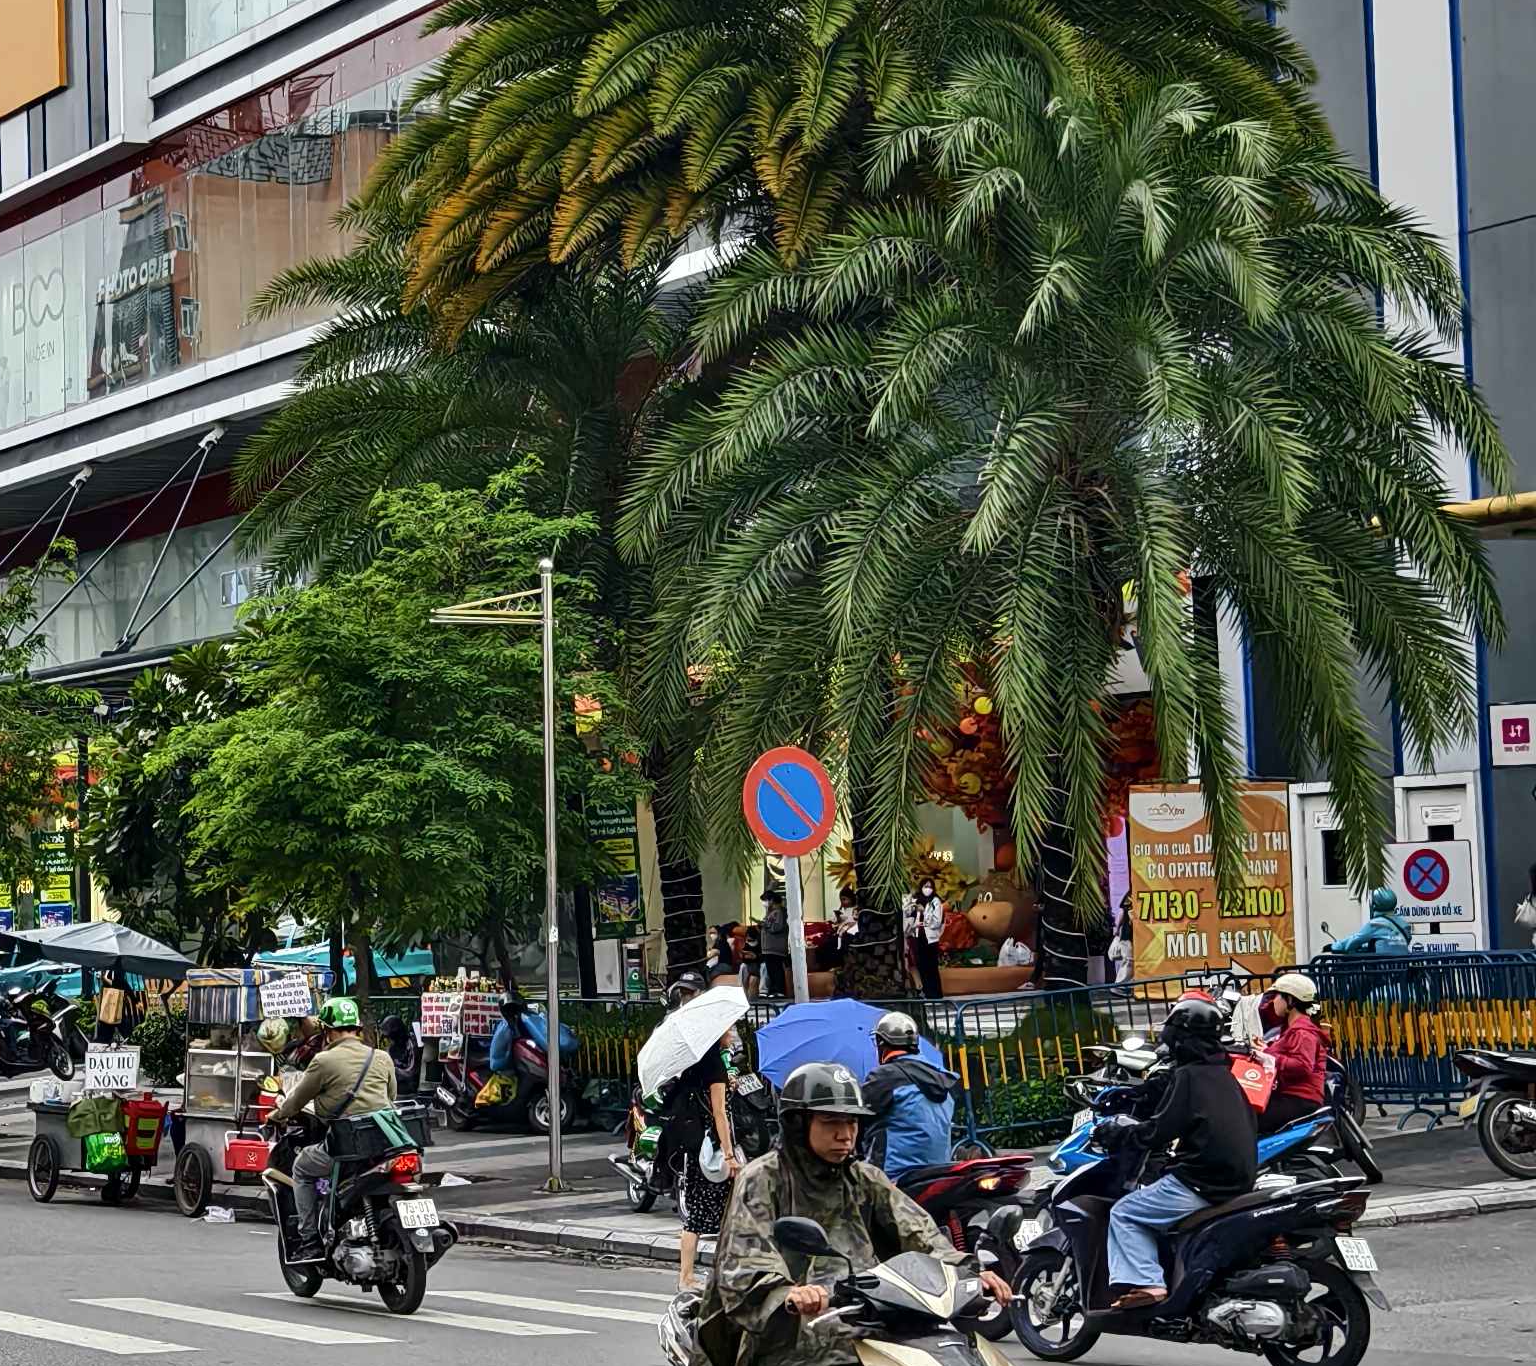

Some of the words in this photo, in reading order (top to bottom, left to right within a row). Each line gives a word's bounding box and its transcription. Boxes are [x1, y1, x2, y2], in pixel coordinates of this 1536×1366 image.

[1138, 889, 1199, 921] 7H30
[1453, 905, 1463, 916] XE
[93, 1072, 129, 1088] NÓNG
